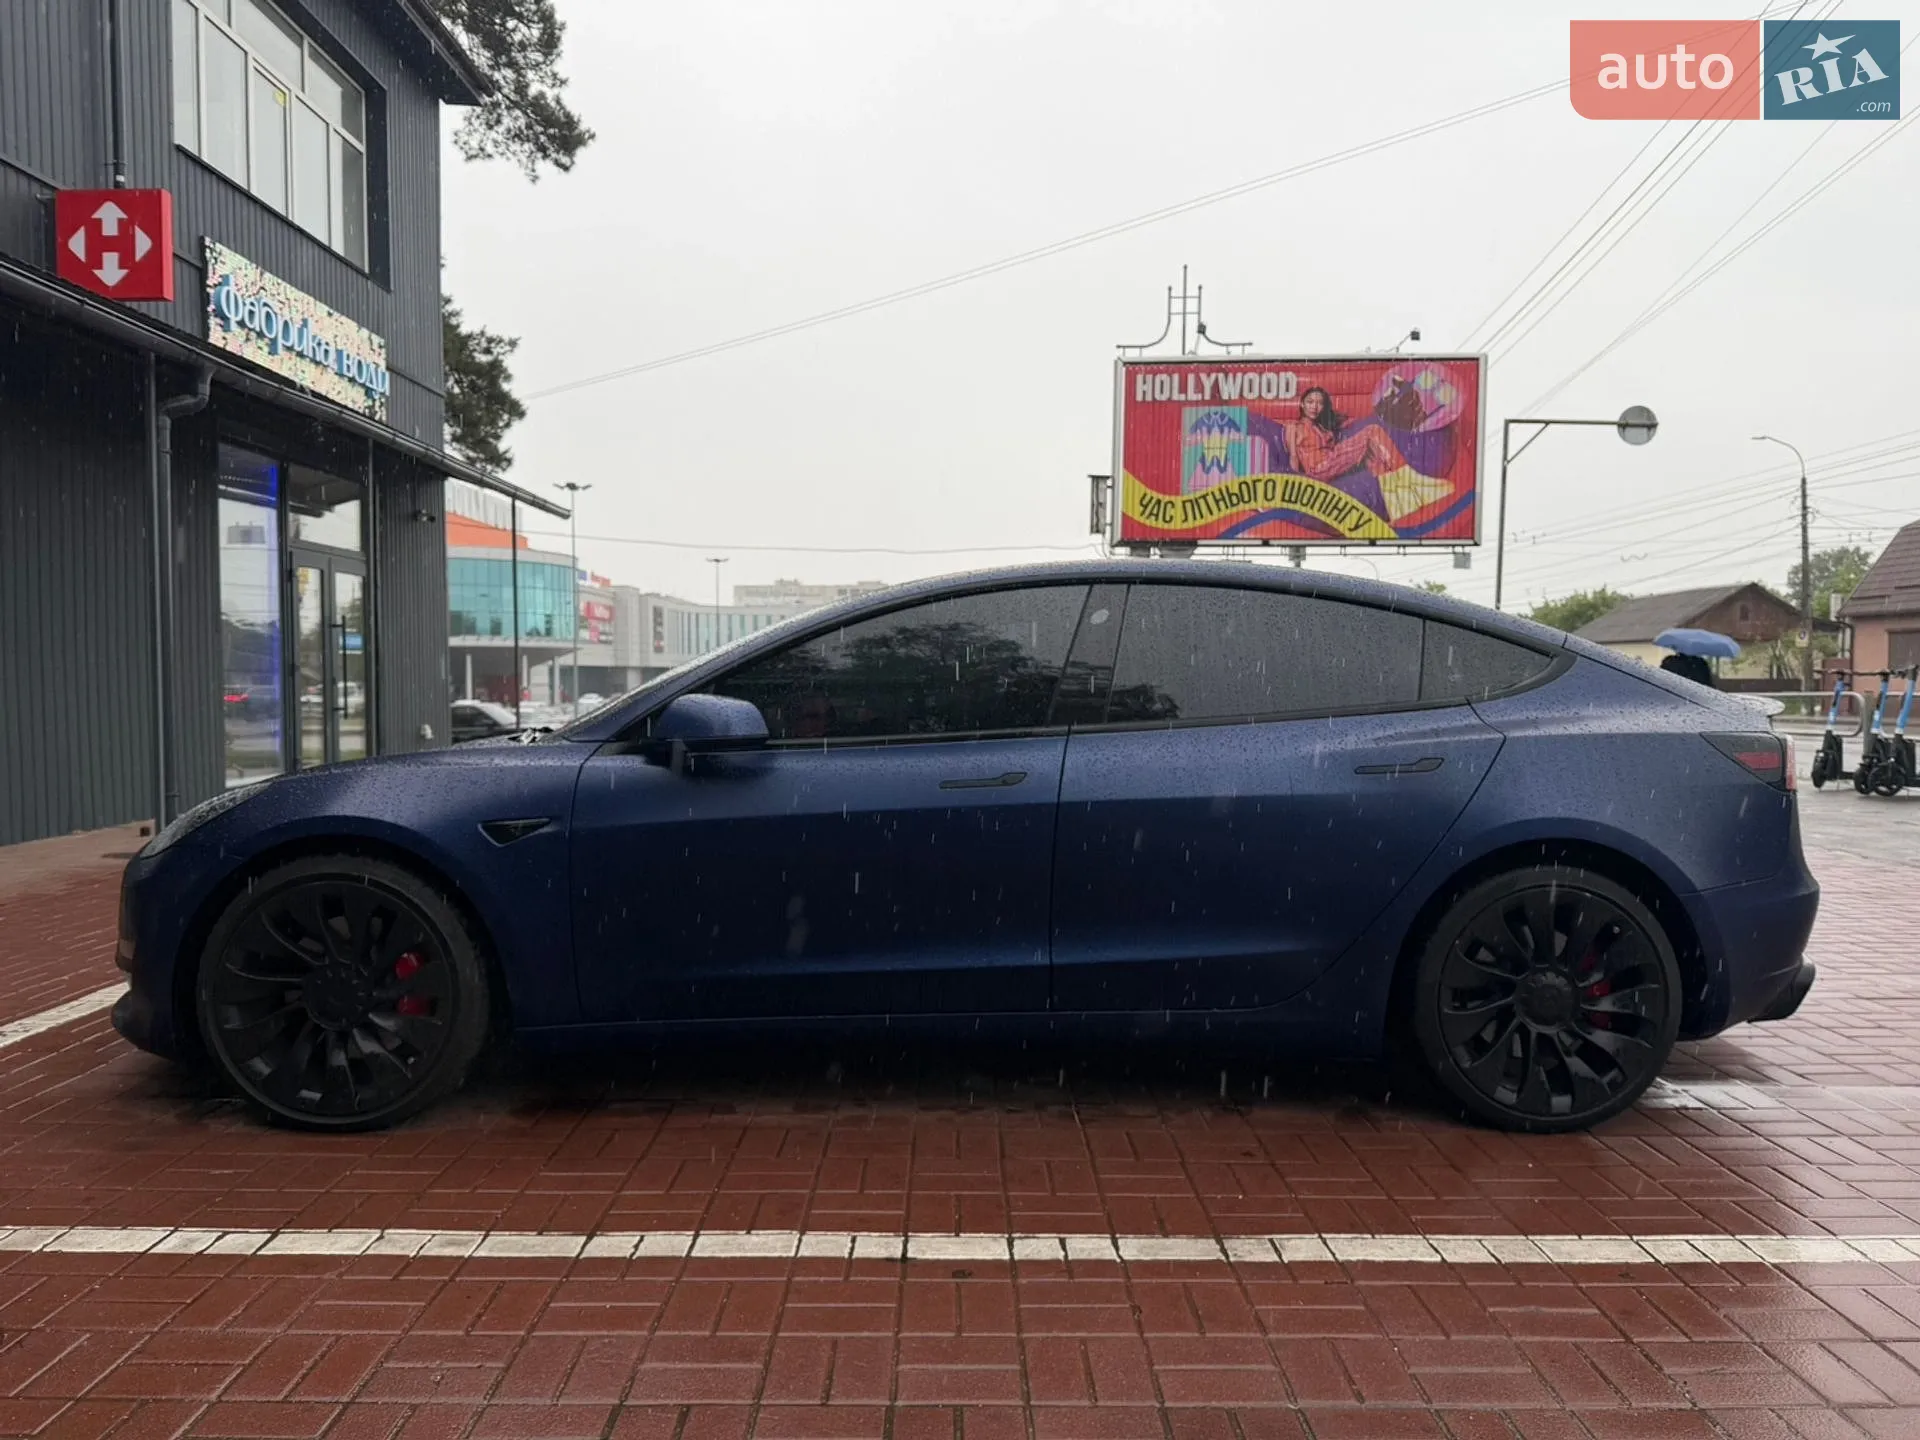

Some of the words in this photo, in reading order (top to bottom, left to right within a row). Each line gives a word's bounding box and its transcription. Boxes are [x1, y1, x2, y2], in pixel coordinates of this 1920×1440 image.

[1135, 370, 1297, 402] HOLLYWOOD
[1139, 492, 1175, 523] ЧАС
[1181, 478, 1277, 523] ЛІТНЬОГО
[1281, 479, 1373, 533] ШОПІНГУ
